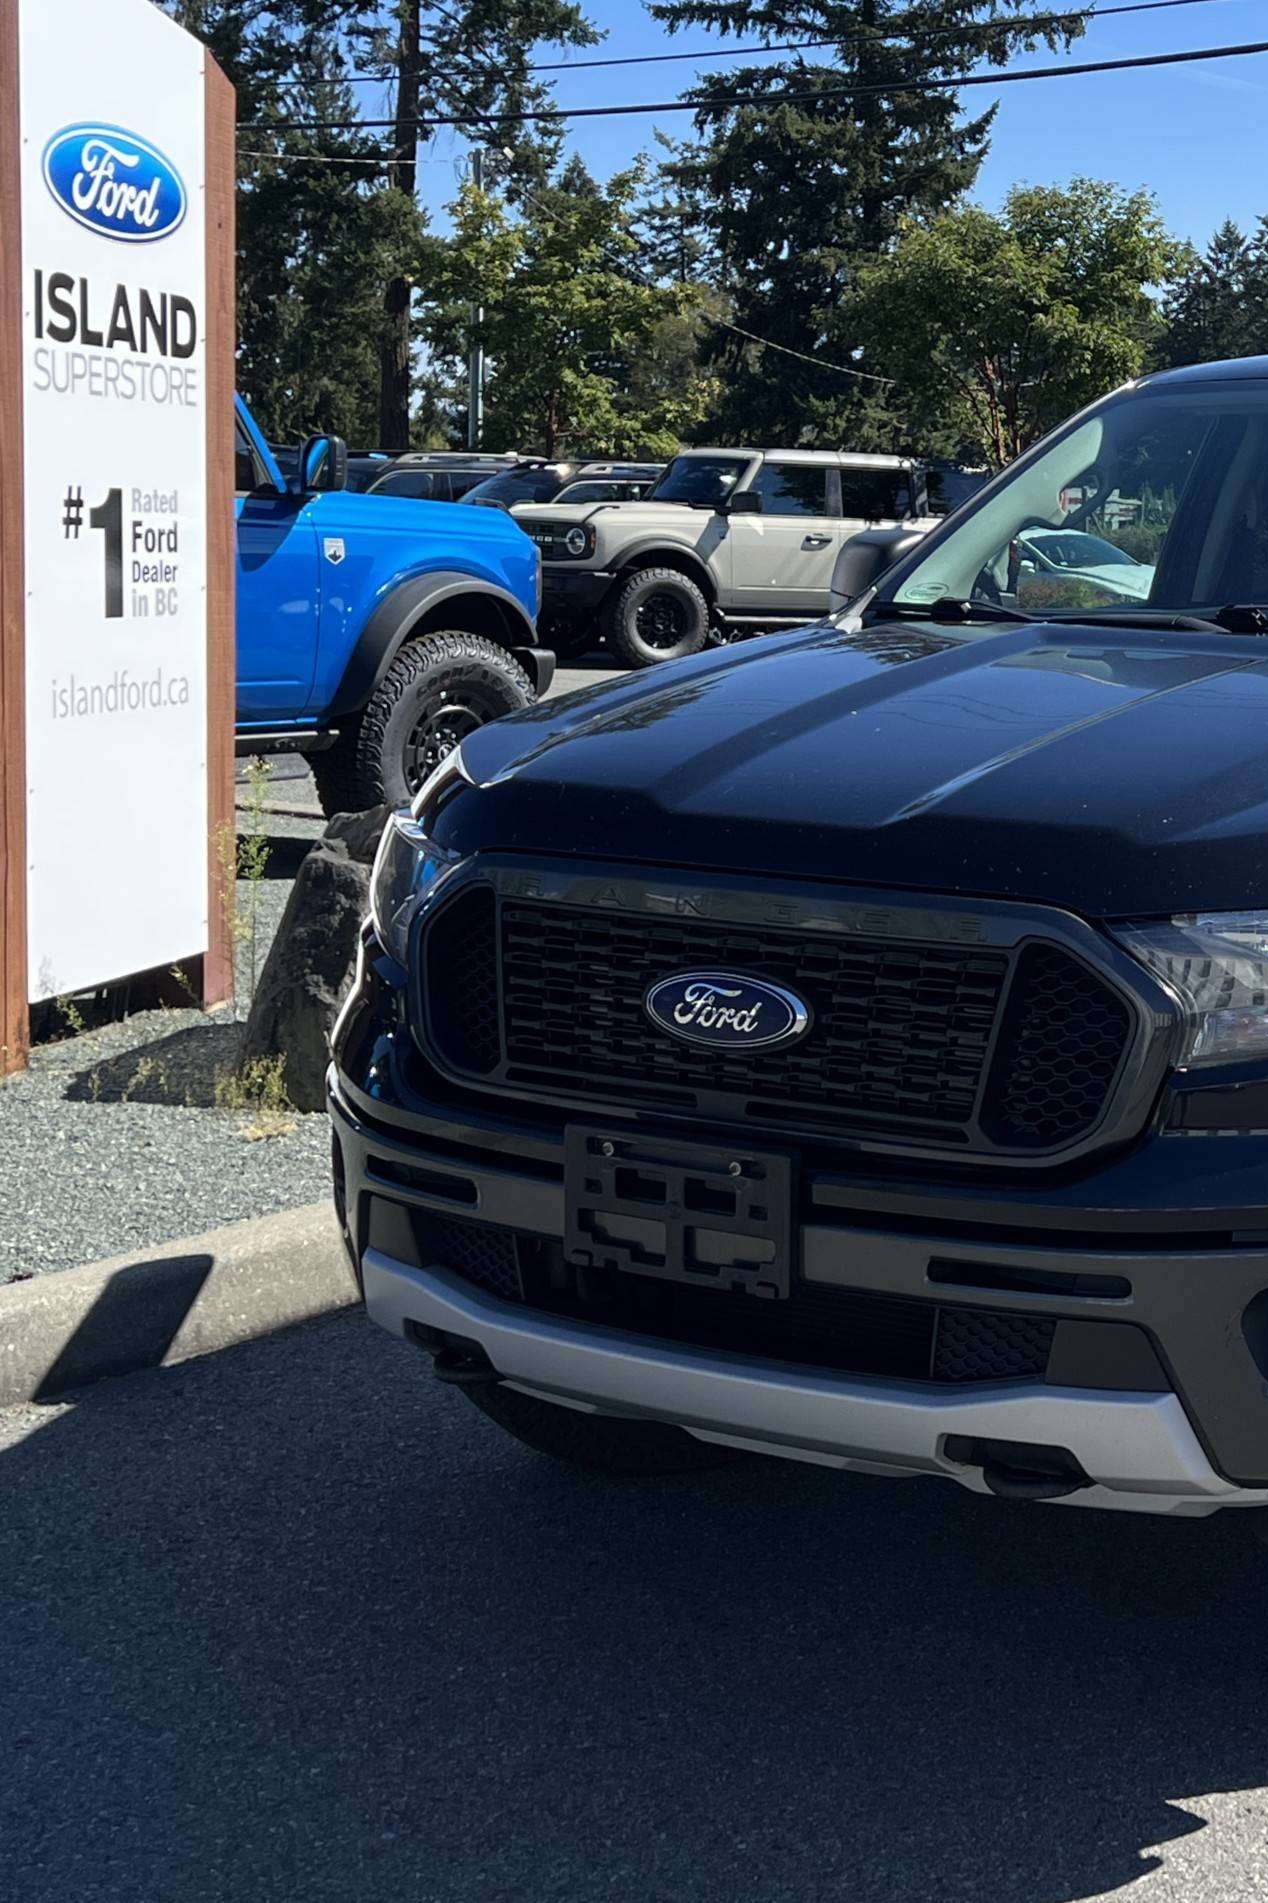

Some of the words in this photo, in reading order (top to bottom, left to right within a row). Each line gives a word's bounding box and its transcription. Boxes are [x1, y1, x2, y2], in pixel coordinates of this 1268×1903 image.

[72, 139, 161, 227] Ford
[34, 268, 197, 359] ISLAND
[33, 347, 197, 407] SUPERSTORE
[131, 487, 178, 514] Rated
[62, 485, 123, 618] #1
[131, 520, 178, 553] Ford
[131, 560, 178, 583] Dealer
[131, 588, 149, 617] in
[154, 587, 178, 616] BC
[52, 667, 189, 718] islandford.ca
[674, 983, 763, 1032] Ford
